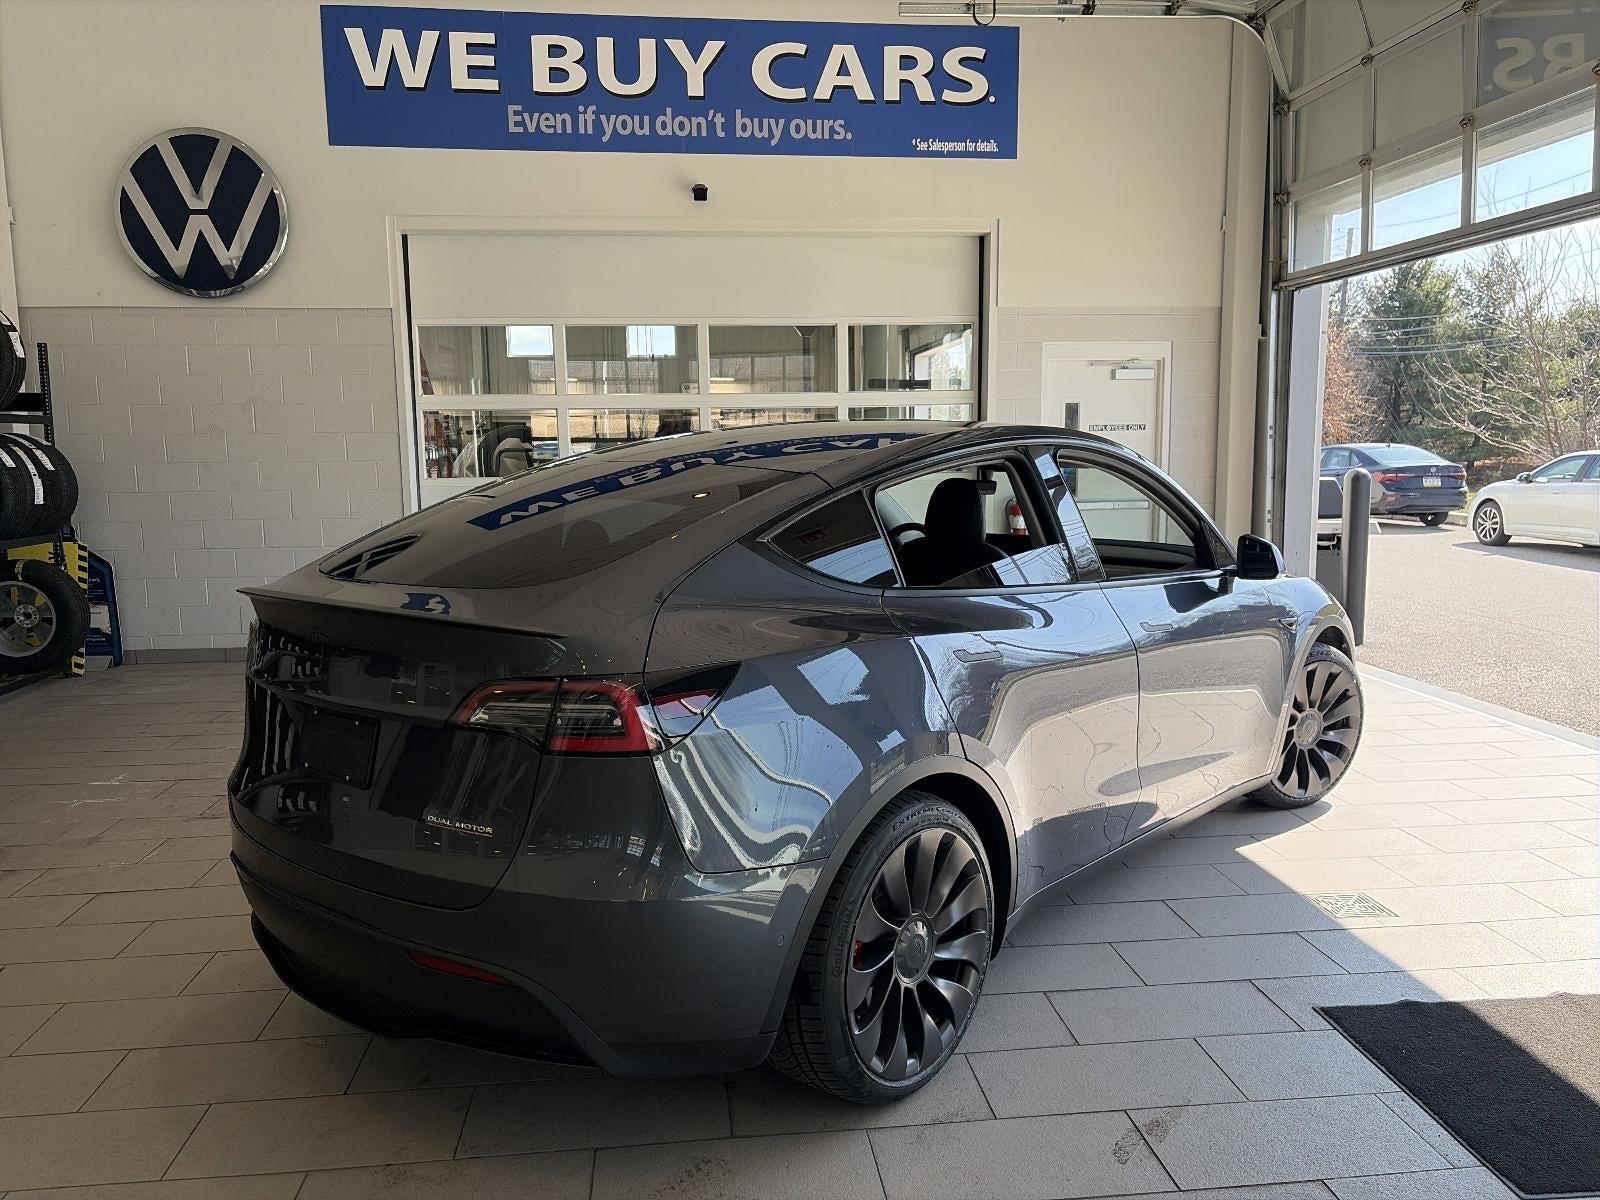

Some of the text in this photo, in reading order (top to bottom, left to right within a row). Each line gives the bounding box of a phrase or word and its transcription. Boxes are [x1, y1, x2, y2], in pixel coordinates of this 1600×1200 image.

[343, 27, 996, 106] WE BUY CARS.
[507, 104, 853, 146] Even if you don't buy ours.
[928, 139, 966, 155] Salesperson
[966, 139, 976, 152] for
[976, 139, 999, 152] details.
[117, 130, 284, 292] VW
[427, 815, 493, 834] DUAL MOTOR
